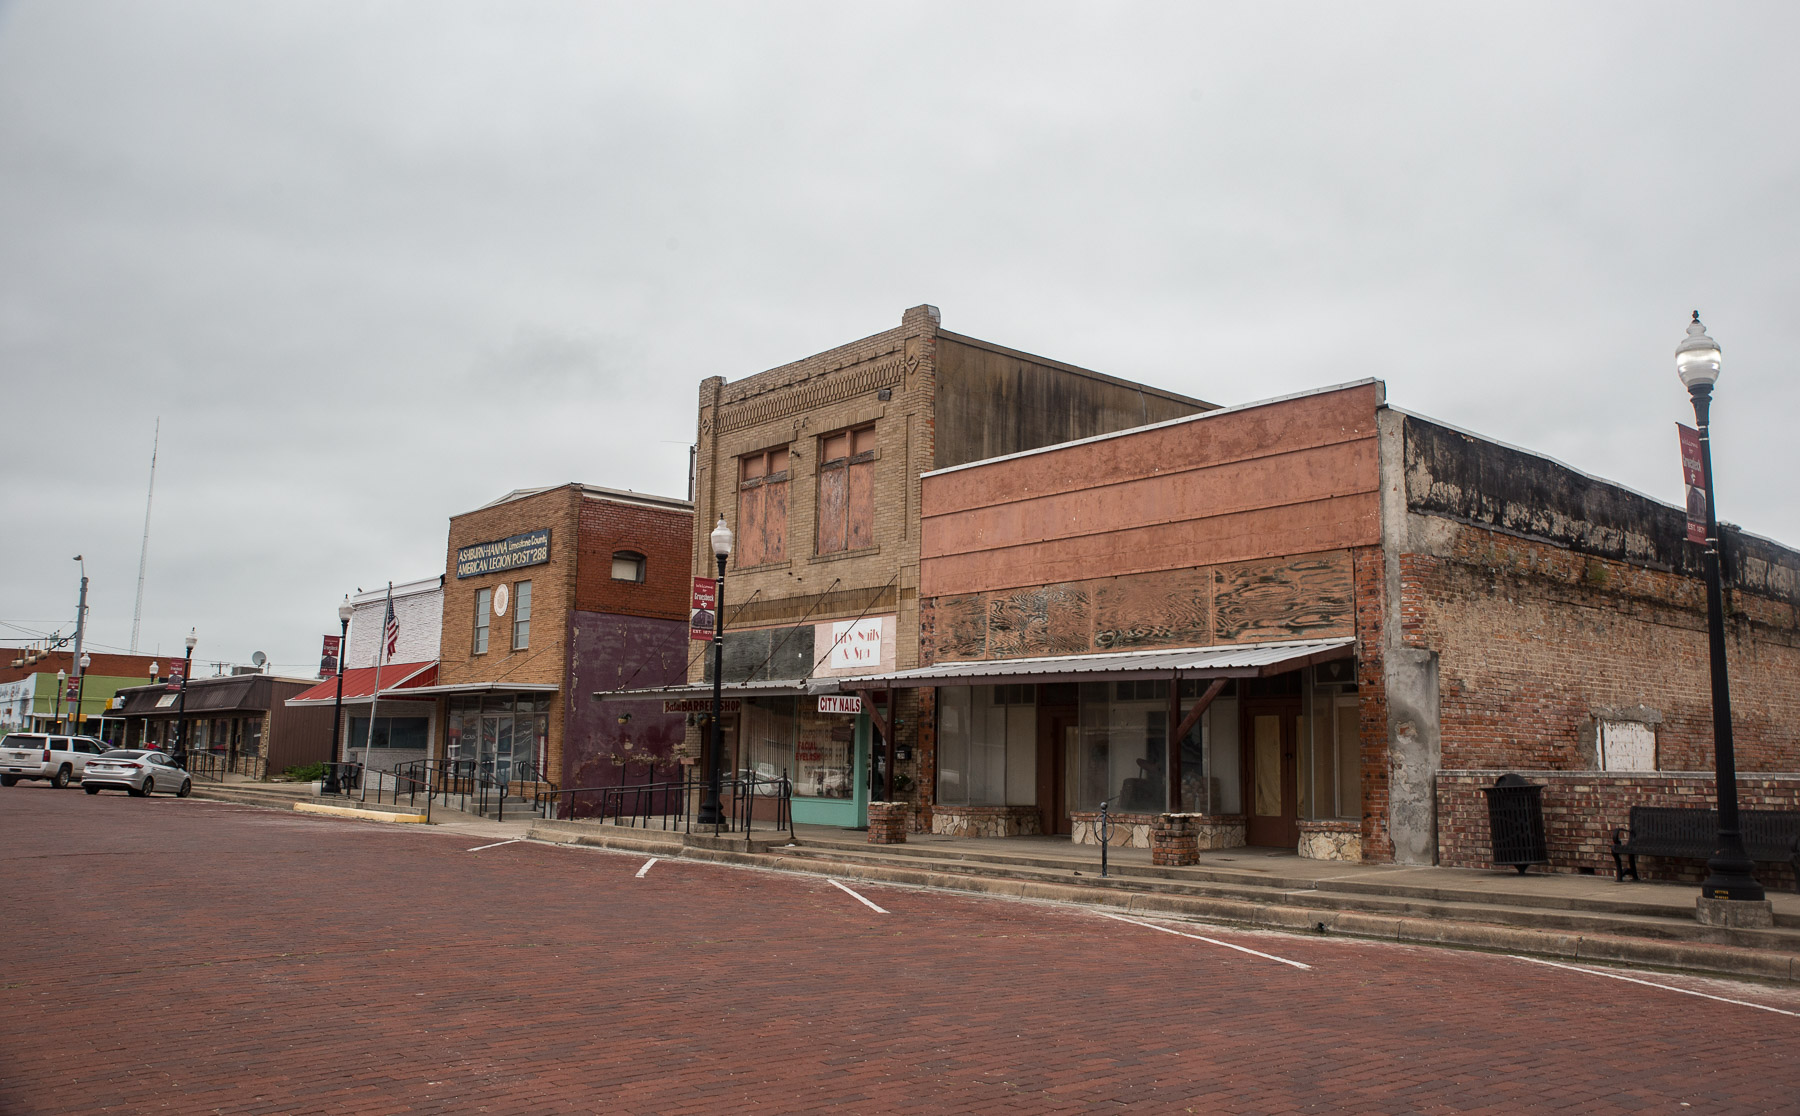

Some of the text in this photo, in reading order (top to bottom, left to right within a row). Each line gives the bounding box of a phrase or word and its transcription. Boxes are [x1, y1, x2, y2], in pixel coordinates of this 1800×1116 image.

[508, 539, 531, 551] Limestone
[531, 534, 548, 546] County
[457, 558, 489, 576] AMERICAN
[488, 554, 512, 570] LEGION
[512, 550, 531, 565] POST
[834, 629, 880, 645] City Nails
[854, 647, 870, 660] Spa
[720, 700, 740, 712] SHOP
[819, 696, 838, 712] CITY
[839, 697, 860, 713] NAILS
[797, 741, 817, 751] FACIAL
